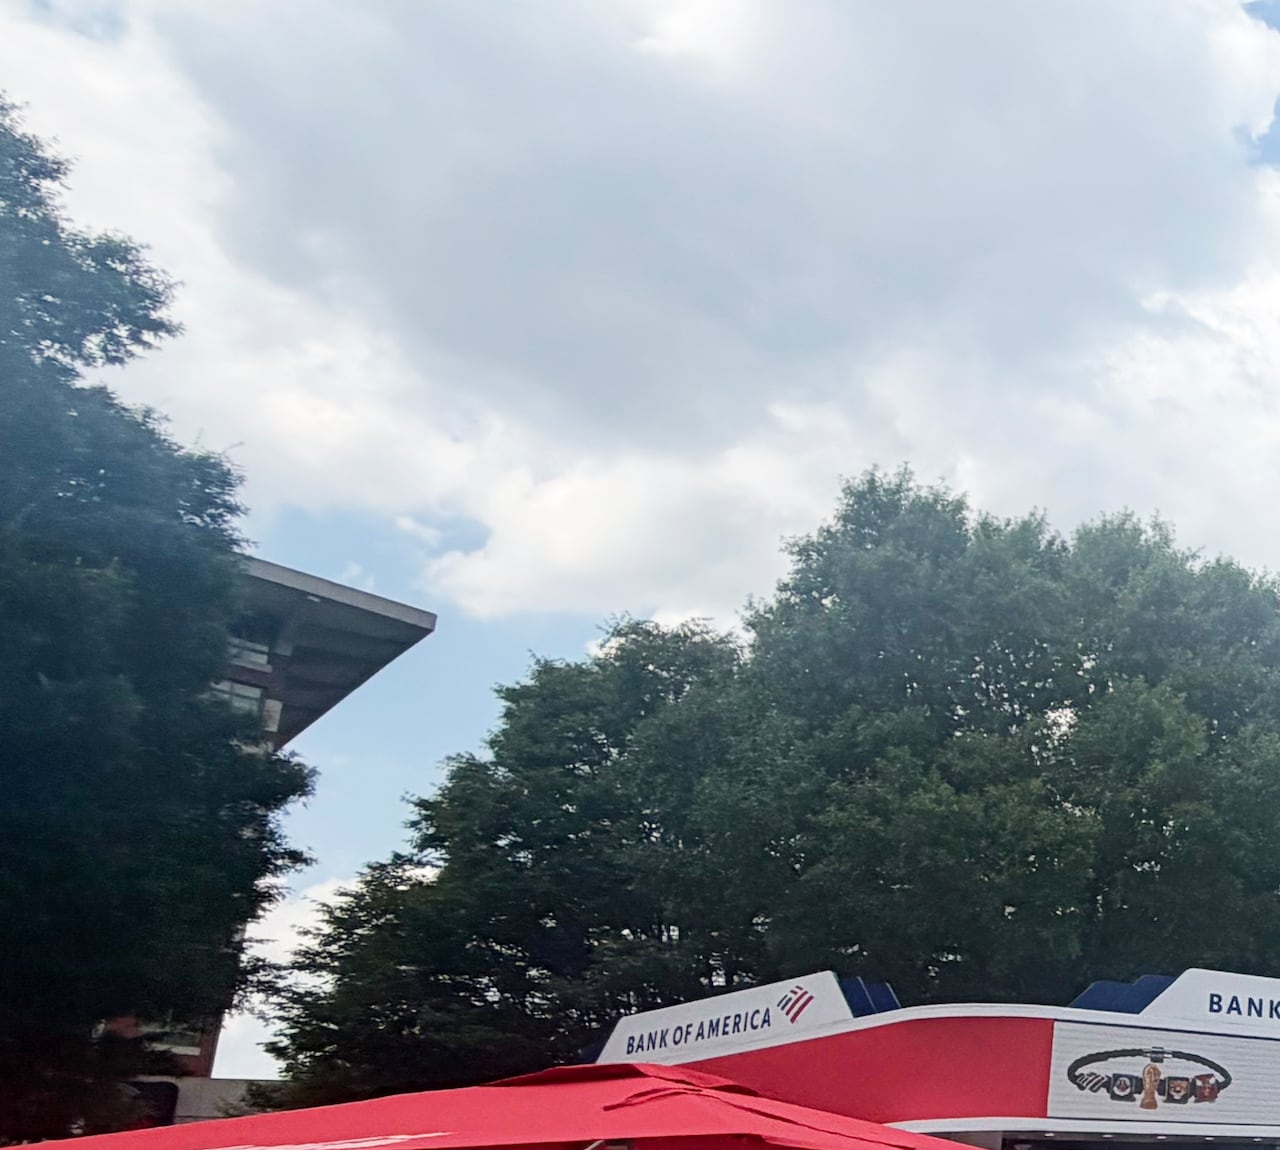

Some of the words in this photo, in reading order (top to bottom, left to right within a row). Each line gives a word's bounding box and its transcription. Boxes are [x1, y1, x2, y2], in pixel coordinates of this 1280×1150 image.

[626, 1027, 671, 1055] BANK
[672, 1023, 692, 1046] OF
[694, 1007, 772, 1042] AMERICA
